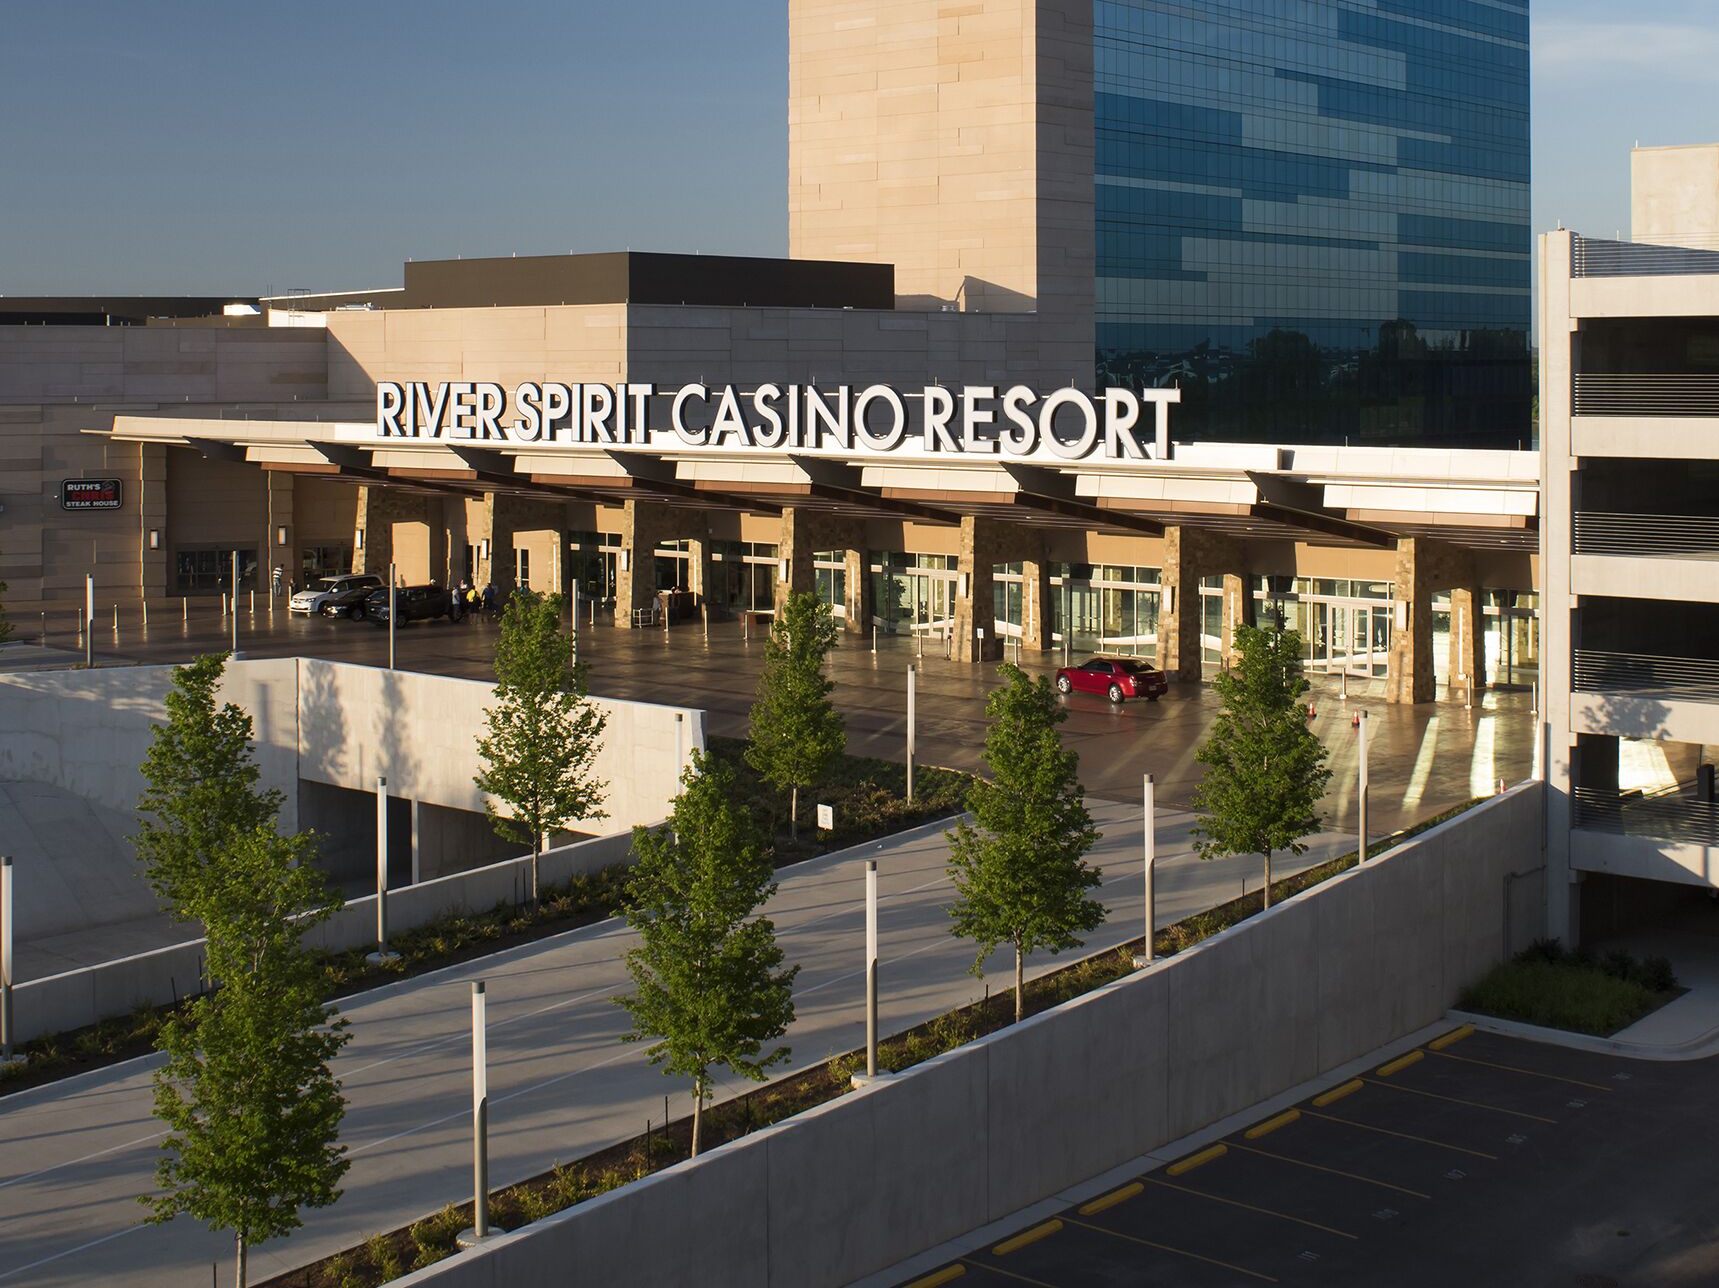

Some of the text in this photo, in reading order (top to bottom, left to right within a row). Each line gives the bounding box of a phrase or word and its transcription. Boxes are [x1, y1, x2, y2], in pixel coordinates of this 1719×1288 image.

[377, 381, 1182, 461] RIVER SPIRIT CASINO RESORT
